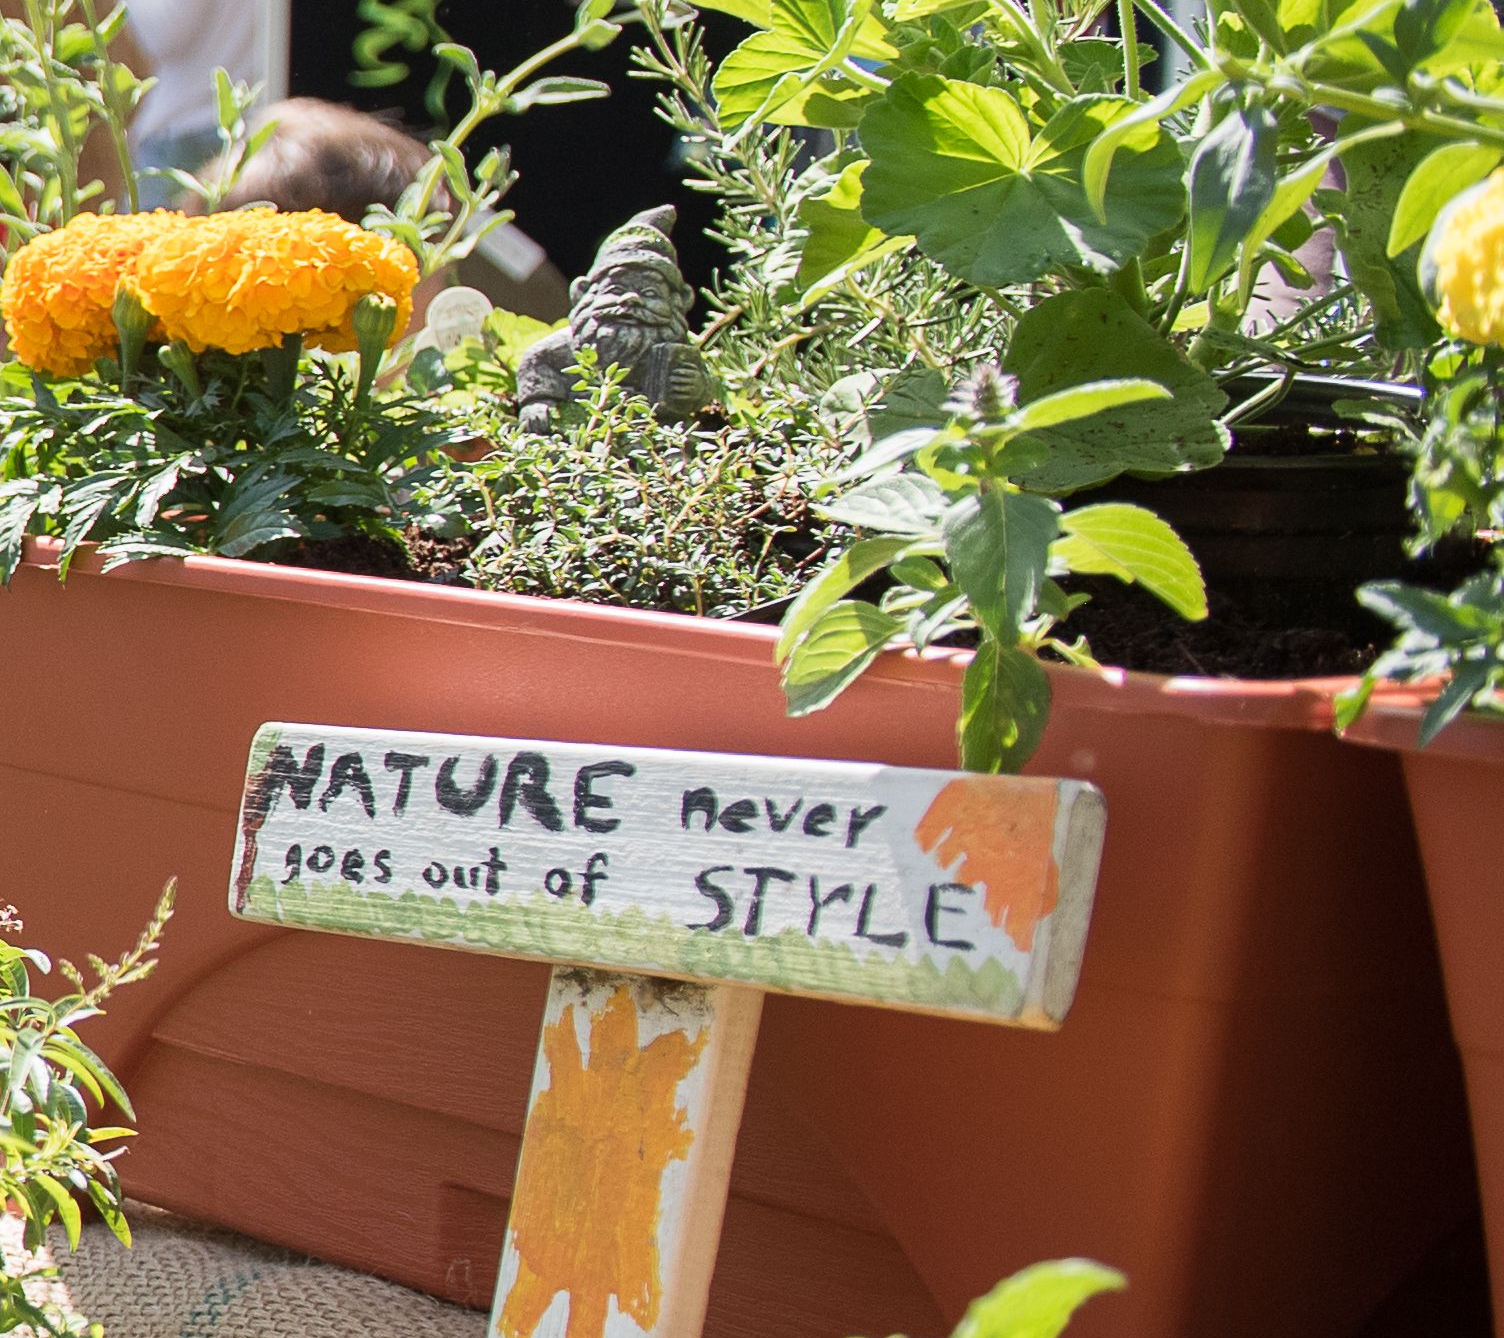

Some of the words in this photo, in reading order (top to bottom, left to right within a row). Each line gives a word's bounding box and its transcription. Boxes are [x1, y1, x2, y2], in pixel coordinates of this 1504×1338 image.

[256, 742, 636, 833] NATURE
[681, 786, 888, 848] never
[281, 843, 393, 885] goes
[422, 846, 508, 895] out
[544, 852, 609, 906] of
[686, 864, 977, 951] STYLE
